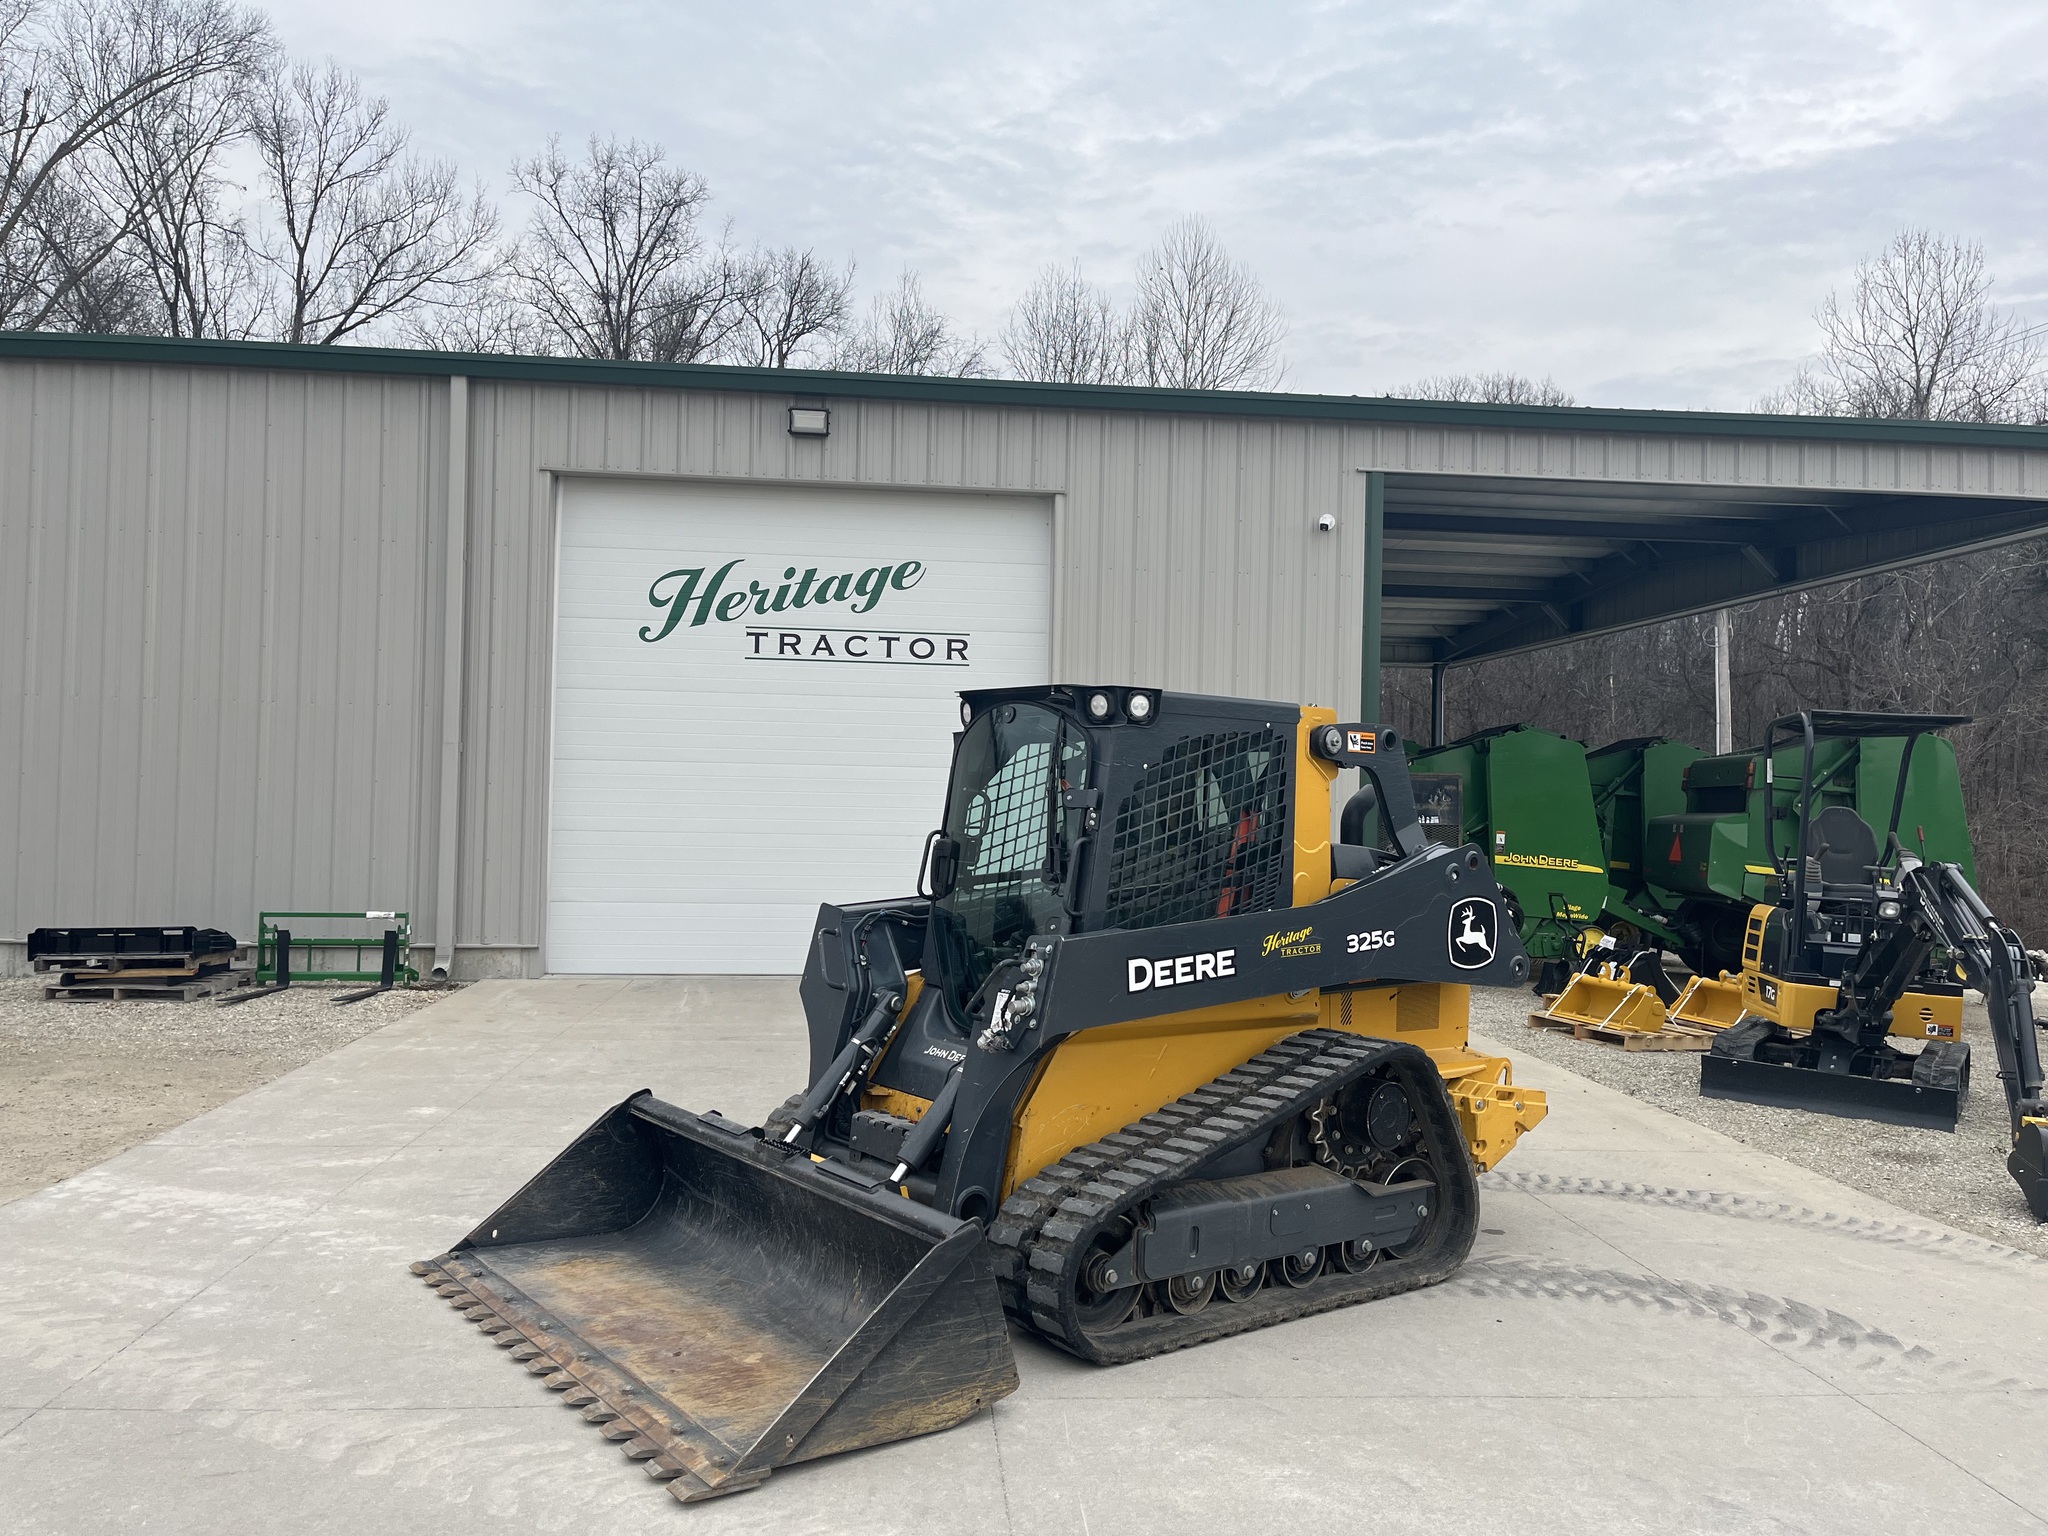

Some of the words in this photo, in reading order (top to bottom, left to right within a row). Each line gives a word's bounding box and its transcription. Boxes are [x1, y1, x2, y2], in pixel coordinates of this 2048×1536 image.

[638, 558, 927, 643] Heritage
[746, 631, 970, 661] TRACTOR
[1504, 852, 1538, 864] JOHN
[1539, 854, 1579, 868] DEERE
[1261, 926, 1313, 957] Heritage
[1281, 945, 1321, 956] TRACTOR
[1346, 929, 1396, 954] 325G
[1127, 949, 1236, 993] DEERE
[1765, 985, 1775, 1001] 17G
[924, 1045, 949, 1059] JOHN
